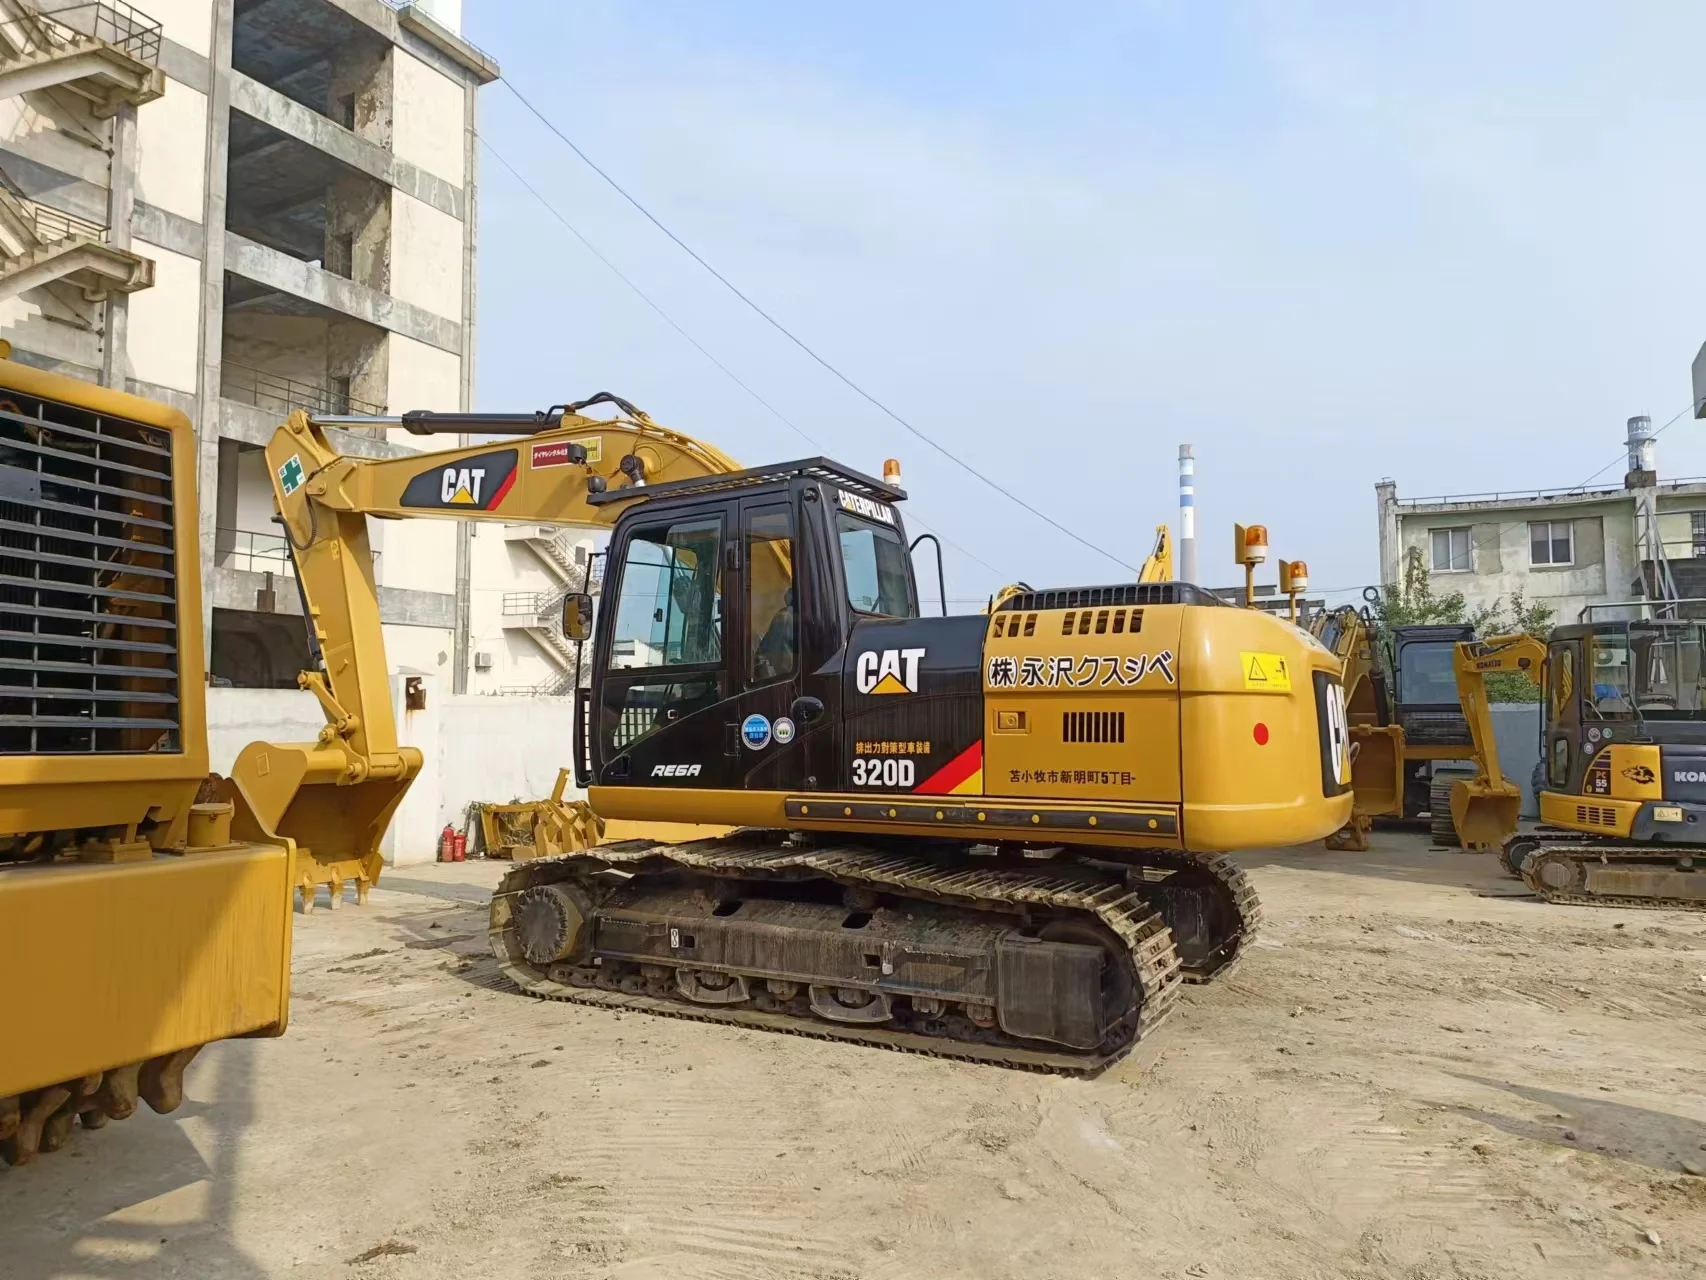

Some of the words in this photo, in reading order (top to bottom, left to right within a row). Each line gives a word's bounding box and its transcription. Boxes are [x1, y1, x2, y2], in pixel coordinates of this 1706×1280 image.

[441, 467, 485, 504] CAT
[838, 489, 895, 525] CATERPILLAR
[856, 648, 926, 694] CAT
[650, 764, 702, 777] REGA
[852, 758, 915, 787] 320D
[1595, 770, 1607, 778] PC
[1595, 779, 1608, 787] 55
